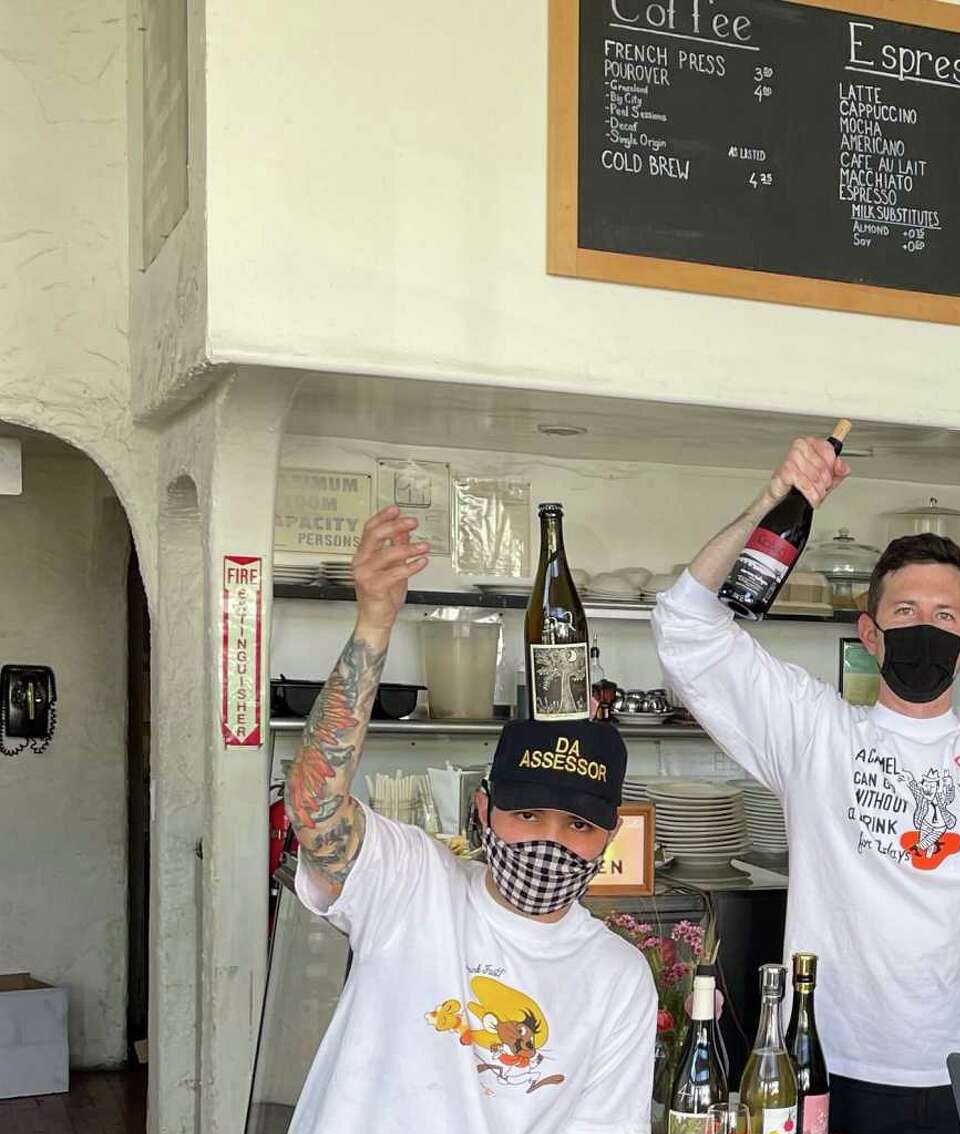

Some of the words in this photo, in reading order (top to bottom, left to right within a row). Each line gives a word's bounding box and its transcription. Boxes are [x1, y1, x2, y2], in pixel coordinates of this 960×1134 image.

[611, 0, 751, 41] Coffee
[604, 40, 668, 66] FRENCH
[679, 51, 726, 77] PRESS
[604, 60, 670, 86] POUROVER
[839, 82, 882, 104] LATTE
[839, 100, 918, 124] CAPPUCCINO
[839, 117, 883, 137] MOCHA
[840, 134, 905, 157] AMERICANO
[601, 150, 643, 173] COLD
[649, 155, 690, 180] BREW
[840, 151, 872, 170] CAFE
[878, 158, 894, 173] AU
[898, 159, 927, 176] LAIT
[839, 168, 913, 192] MACCHIATO
[839, 184, 897, 206] ESPRESSO
[852, 203, 875, 220] MILK
[877, 205, 940, 227] SUBSTITUTES
[298, 532, 361, 548] PERSONS
[227, 567, 258, 585] FIRE
[235, 589, 248, 737] EXTINGUISHER
[555, 736, 580, 758] DA
[519, 749, 608, 784] ASSESSOR
[867, 748, 901, 776] CMEL
[853, 771, 878, 787] CAN
[860, 814, 898, 835] RINK
[858, 831, 873, 854] for
